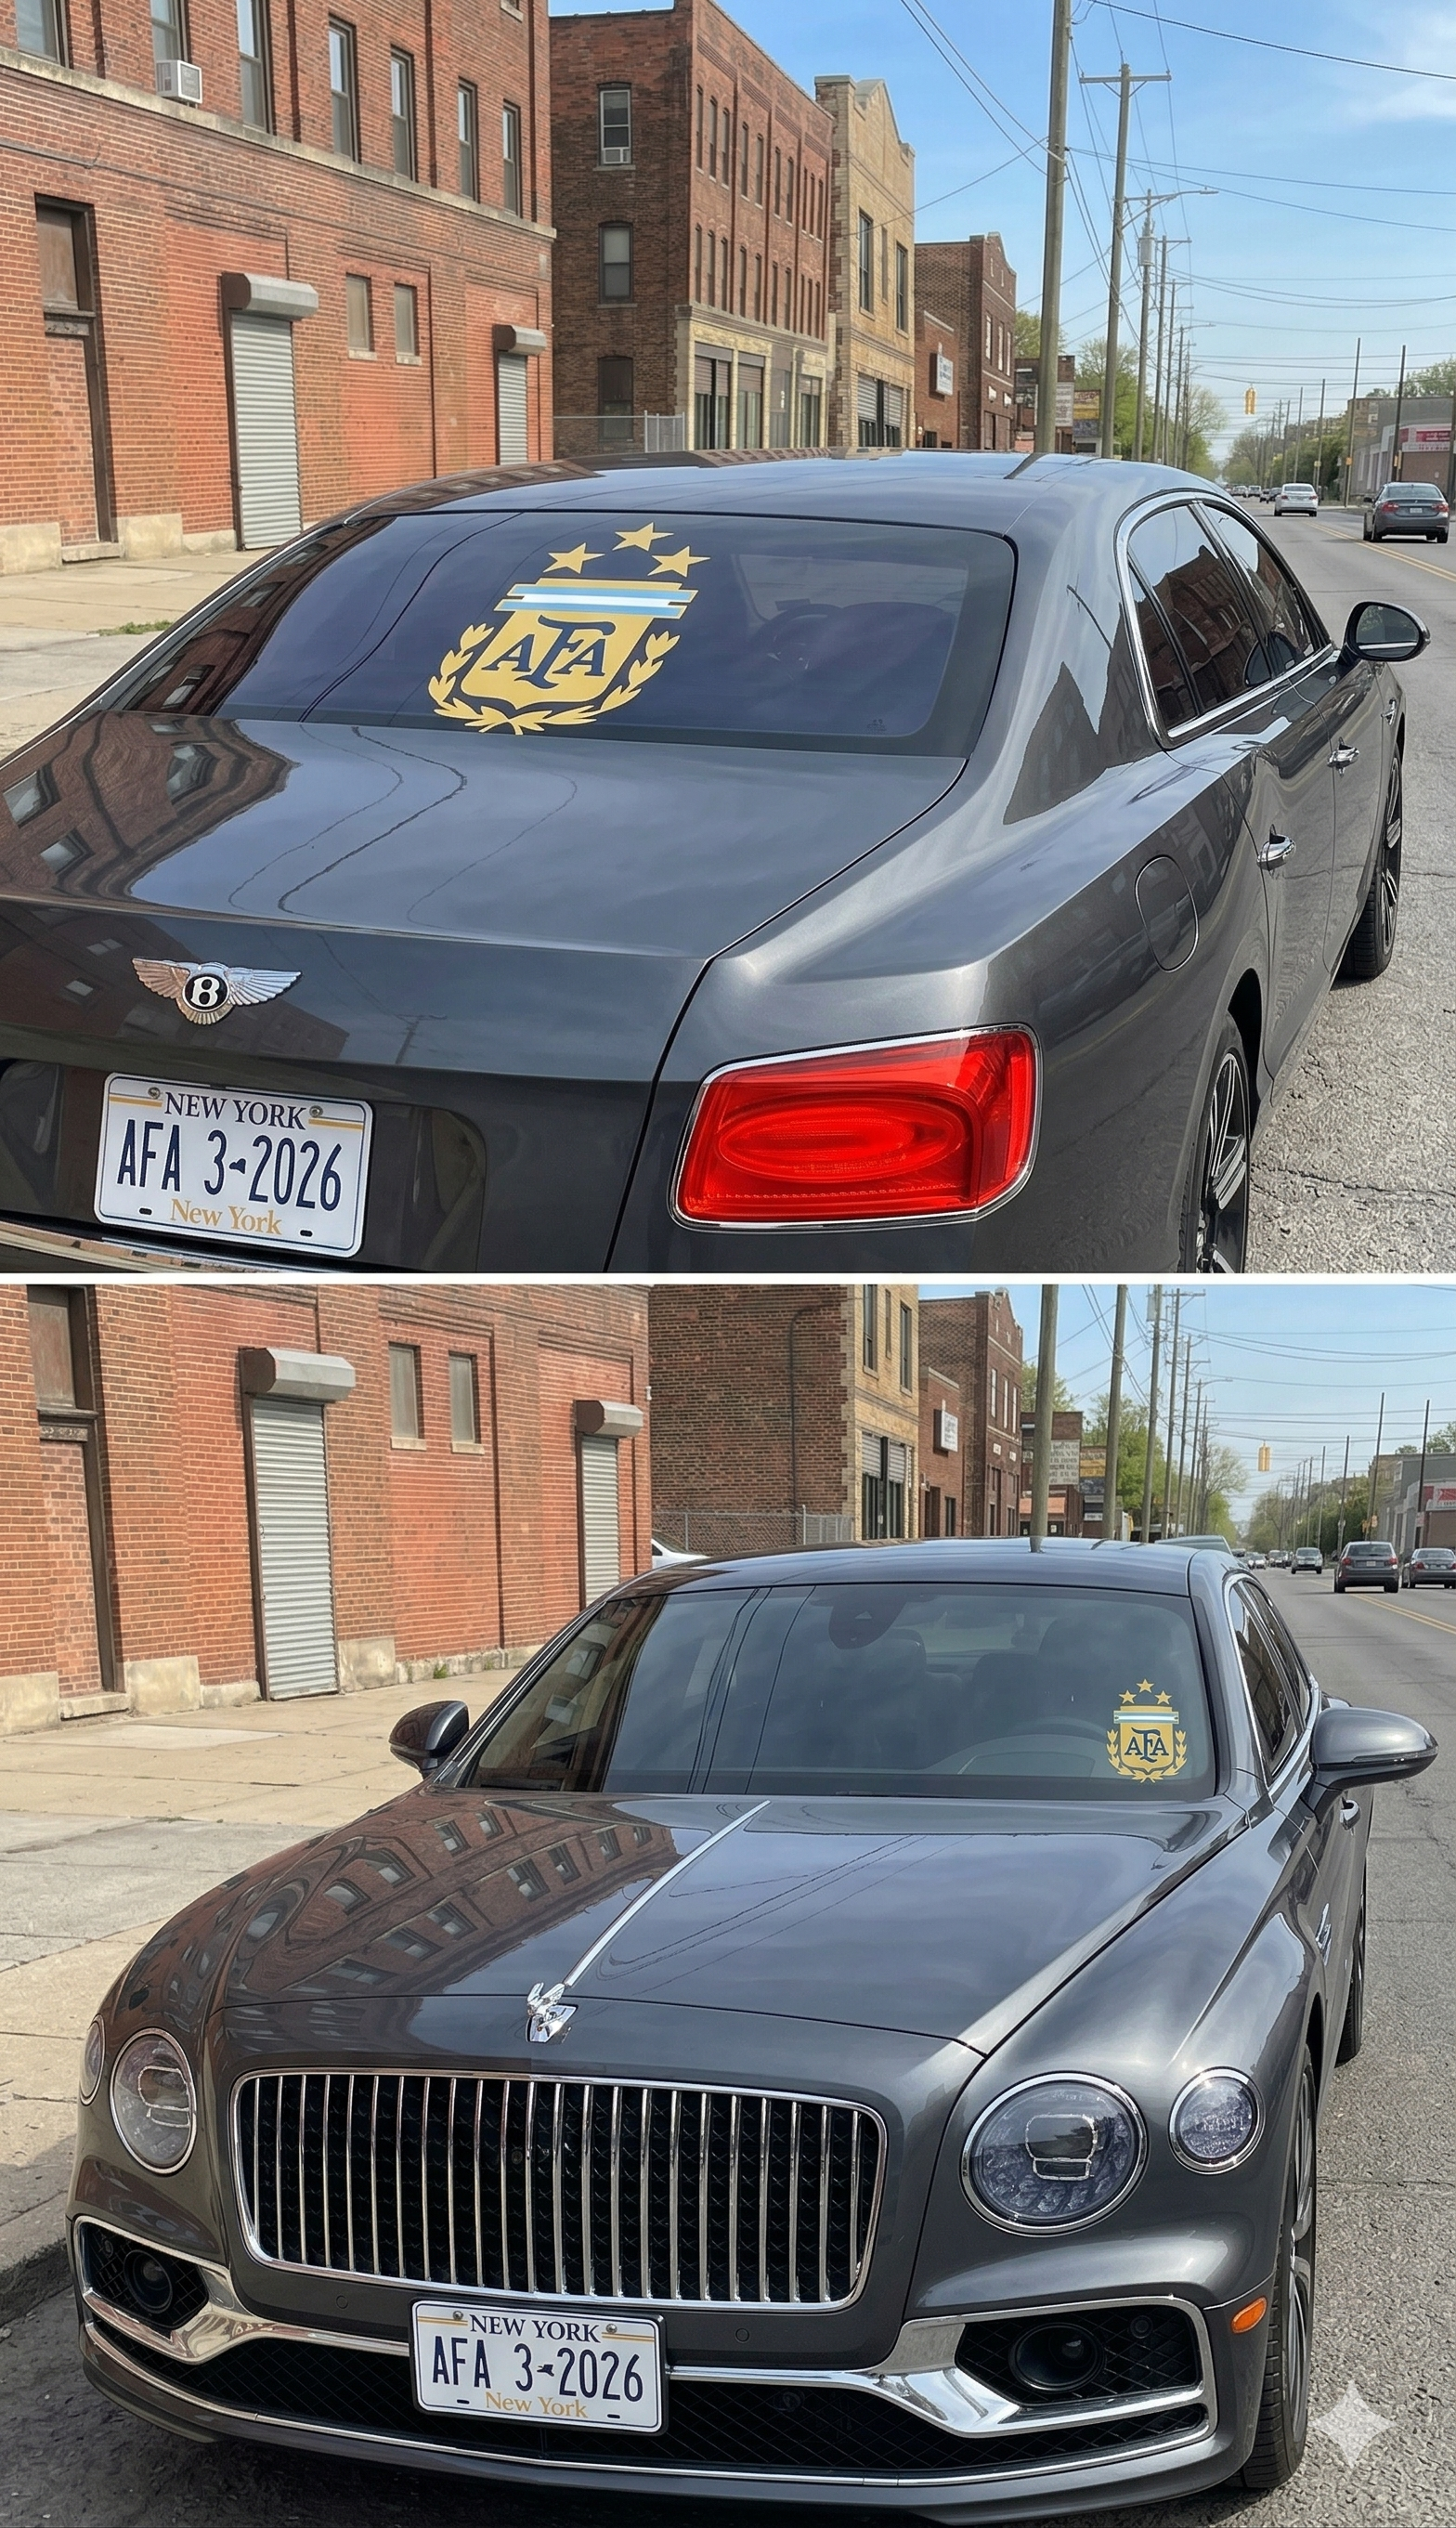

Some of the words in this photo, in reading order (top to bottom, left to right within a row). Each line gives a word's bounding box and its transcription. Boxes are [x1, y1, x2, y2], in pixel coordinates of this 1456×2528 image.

[481, 614, 617, 688] AFA
[163, 1091, 228, 1119] NEW
[232, 1101, 307, 1130] YORK
[116, 1118, 181, 1192] AFA
[169, 1198, 223, 1227] New
[228, 1205, 283, 1235] York
[1124, 1727, 1170, 1764] AFA
[469, 2313, 526, 2337] NEW
[531, 2320, 602, 2344] YORK
[432, 2335, 492, 2390] AFA
[485, 2391, 532, 2413] New
[538, 2396, 589, 2418] York
